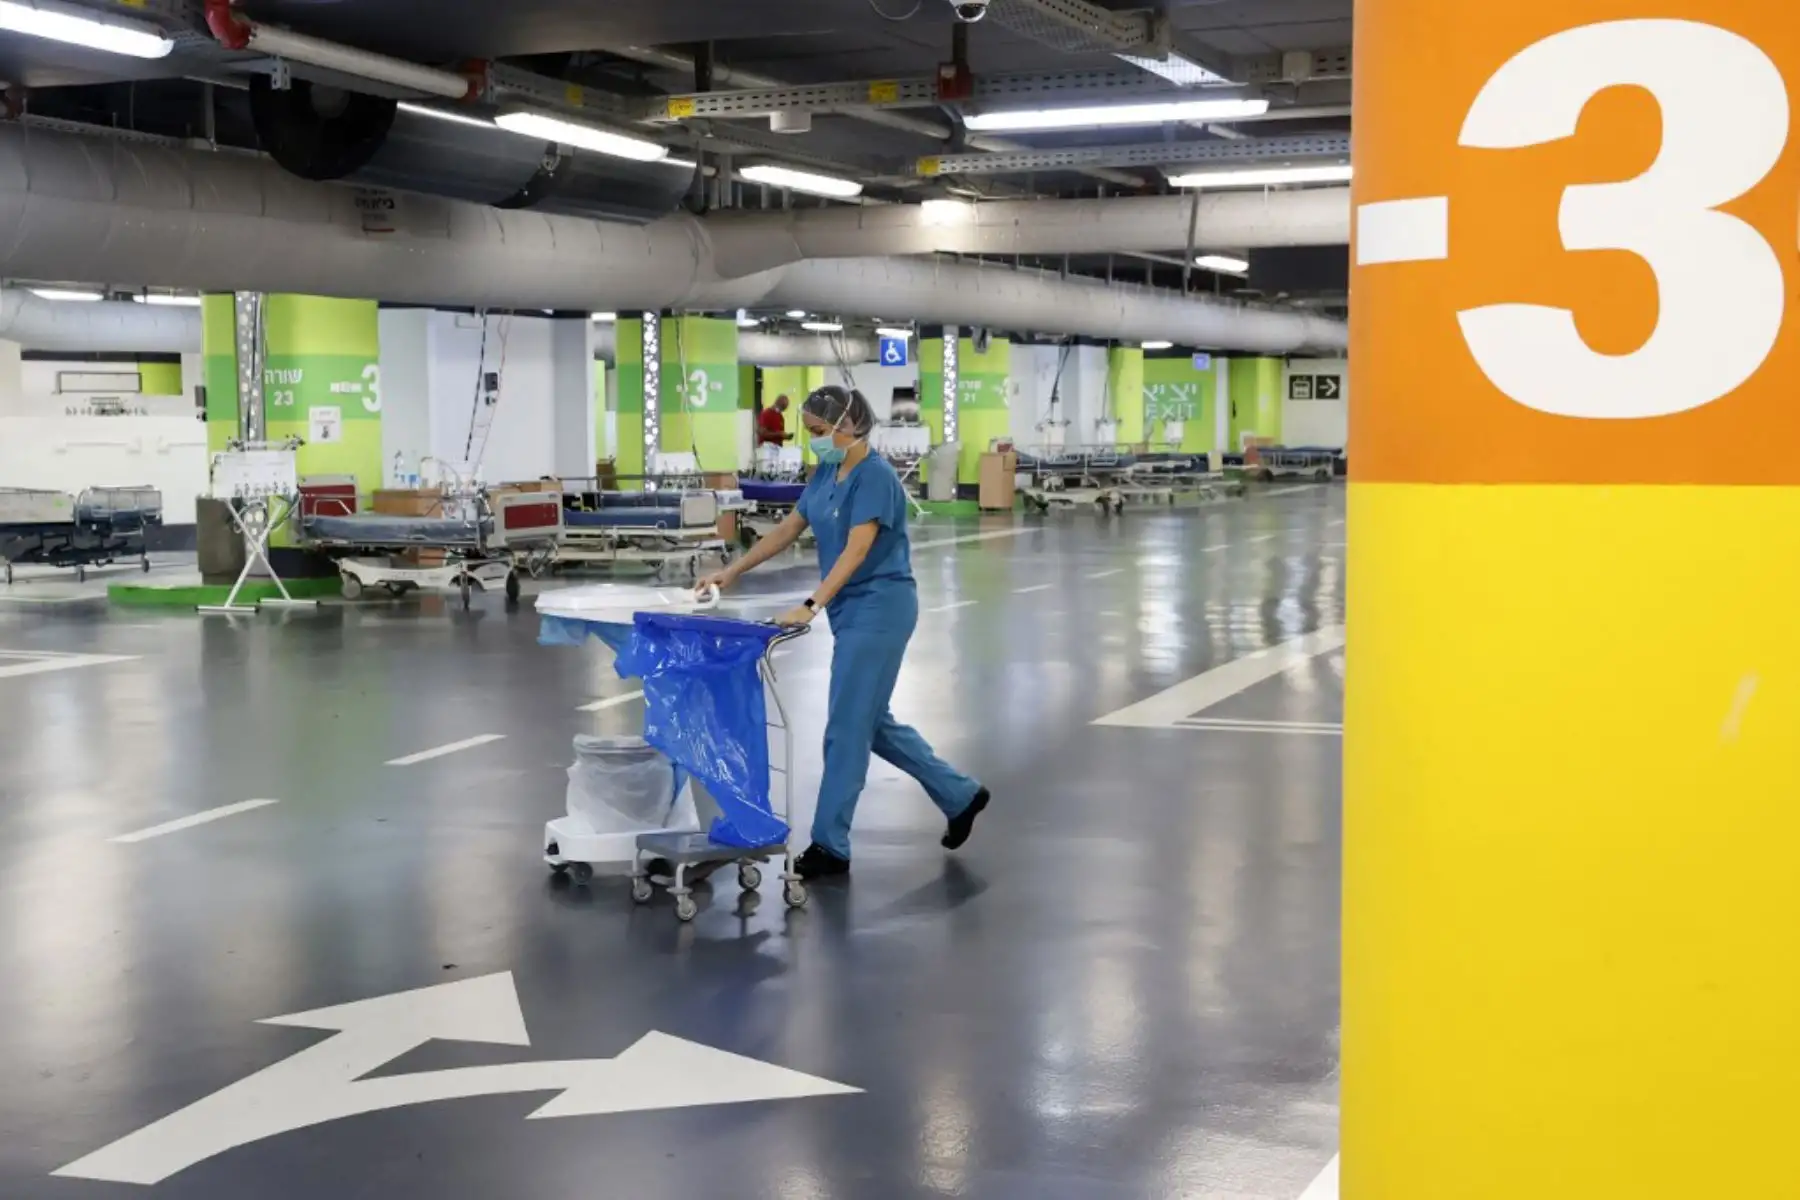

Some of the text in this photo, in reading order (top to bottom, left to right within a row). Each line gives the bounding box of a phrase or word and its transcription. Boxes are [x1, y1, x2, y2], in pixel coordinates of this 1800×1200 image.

[1357, 18, 1790, 419] -3
[264, 368, 304, 385] שורה
[273, 390, 294, 406] 23
[1143, 383, 1197, 401] יציא
[1145, 403, 1197, 420] EXIT
